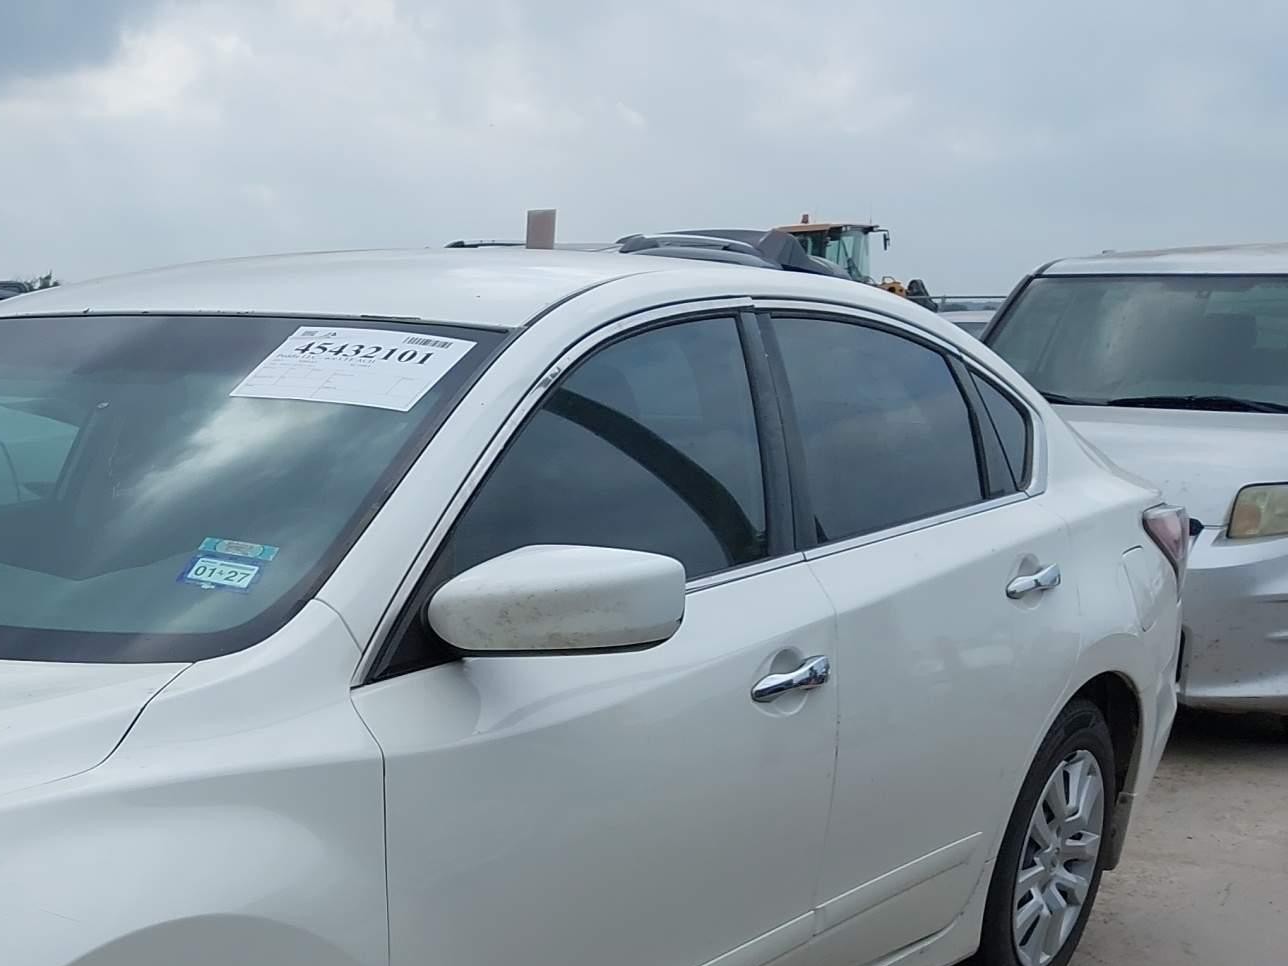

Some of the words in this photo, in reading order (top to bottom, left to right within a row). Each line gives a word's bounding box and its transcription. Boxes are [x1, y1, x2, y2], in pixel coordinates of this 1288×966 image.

[295, 341, 433, 365] 45432101
[194, 566, 217, 578] 01
[224, 571, 250, 582] 27
